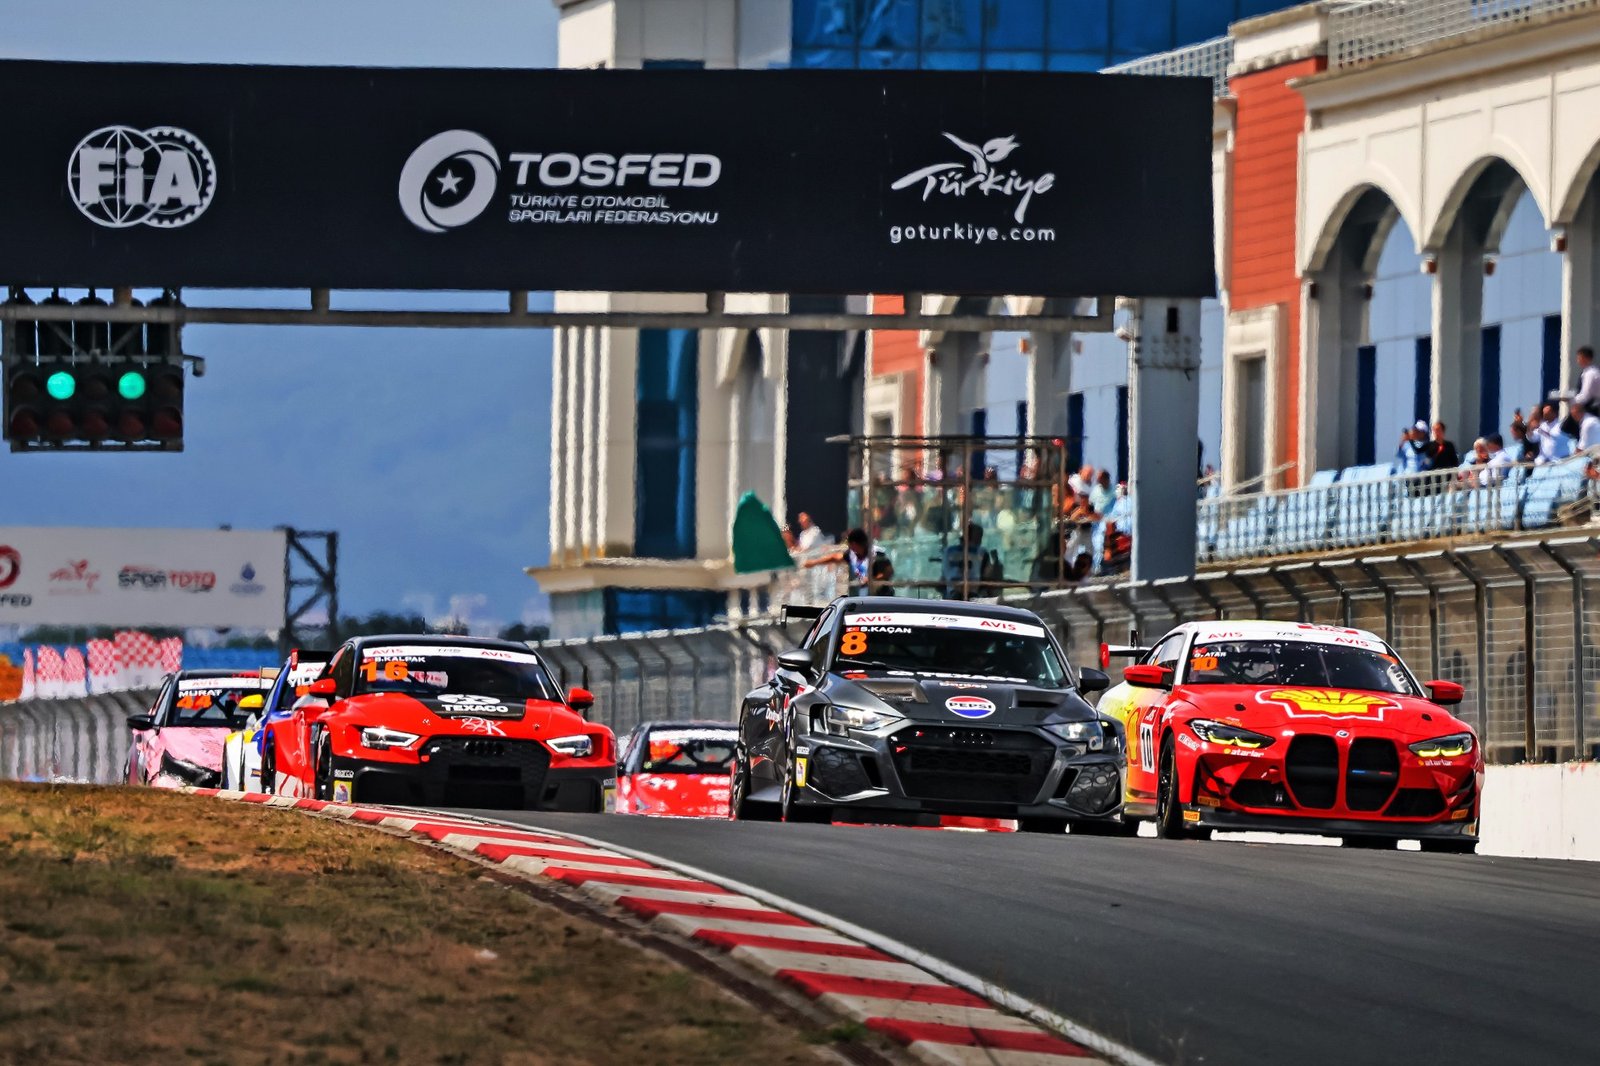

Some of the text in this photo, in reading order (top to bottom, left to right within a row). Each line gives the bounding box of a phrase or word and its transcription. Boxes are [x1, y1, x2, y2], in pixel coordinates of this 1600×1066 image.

[509, 152, 722, 187] TOSFED
[510, 193, 670, 209] TÜRKİYE OTOMOBİL
[891, 162, 1056, 224] Türkiye
[509, 210, 719, 224] SPORLARI FEDERASYONU
[889, 222, 1056, 244] goturkiye.com
[856, 615, 892, 623] AVIS
[980, 620, 1017, 631] AVIS
[860, 626, 912, 634] S.KAÇAN
[840, 631, 868, 655] 8
[1335, 637, 1369, 647] AVIS
[480, 650, 512, 659] AVIS
[359, 661, 408, 682] 16
[1190, 657, 1219, 671] 10
[178, 689, 222, 698] MURAT
[441, 704, 509, 713] TEXACO
[1141, 726, 1153, 769] 10
